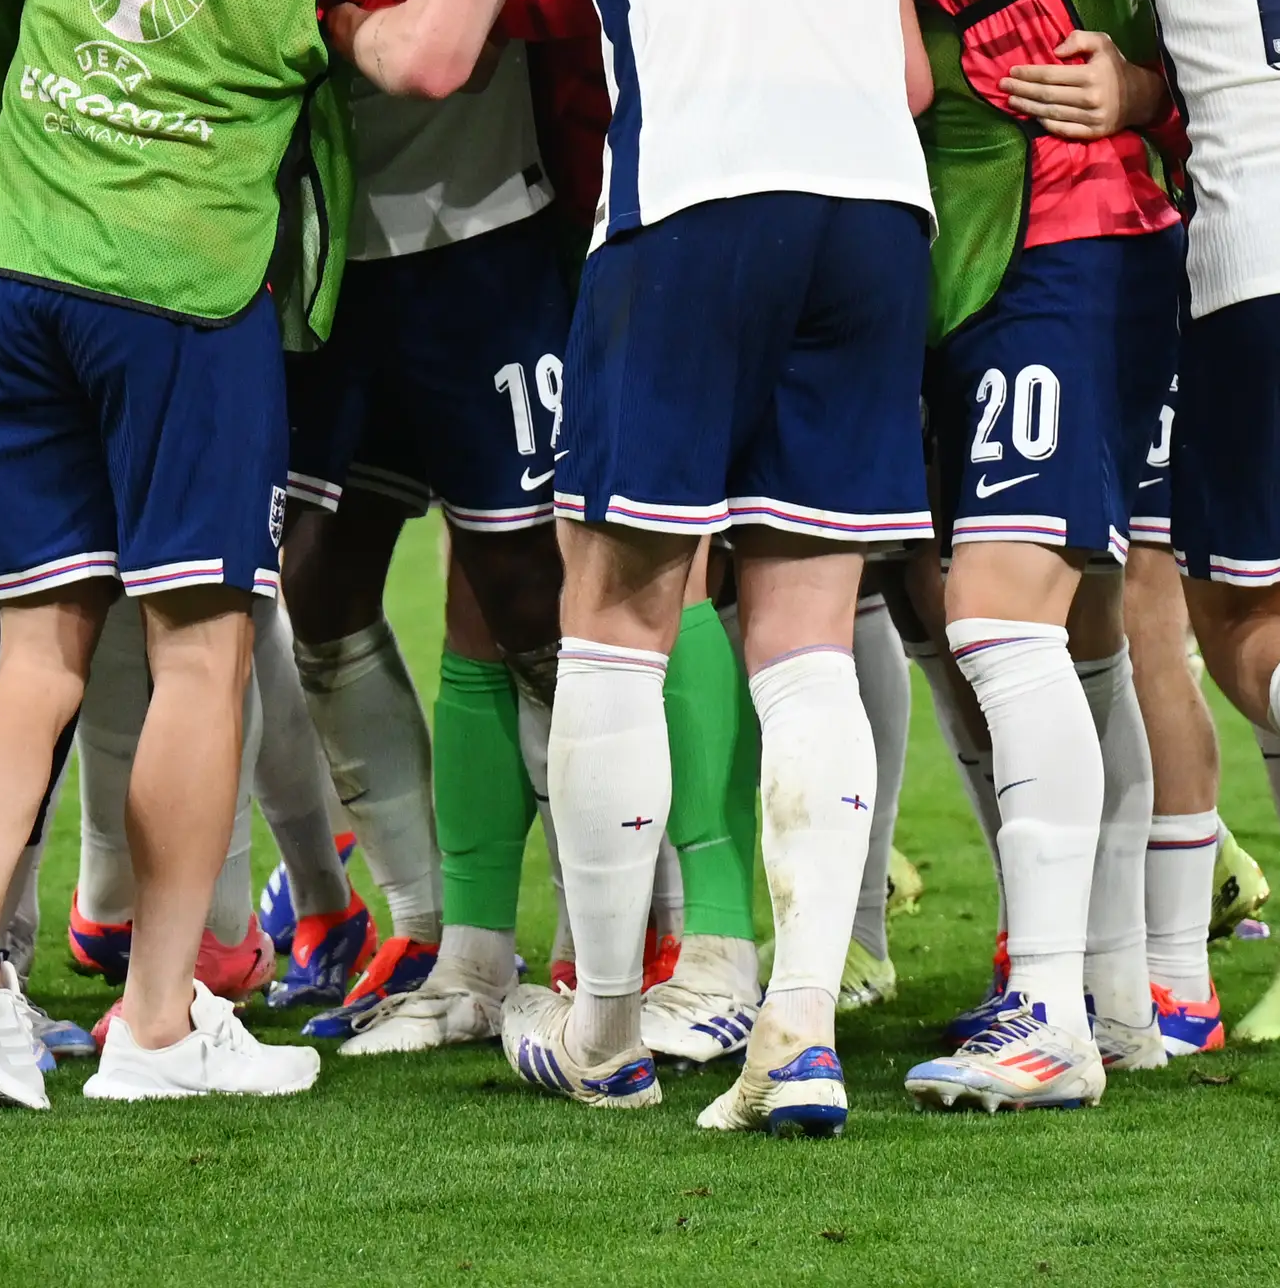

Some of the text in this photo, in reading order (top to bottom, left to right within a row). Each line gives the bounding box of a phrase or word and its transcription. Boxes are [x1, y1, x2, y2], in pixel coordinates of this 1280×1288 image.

[77, 48, 144, 92] UEFA
[43, 112, 153, 150] GEMANY
[494, 353, 565, 456] 19
[970, 364, 1061, 463] 20
